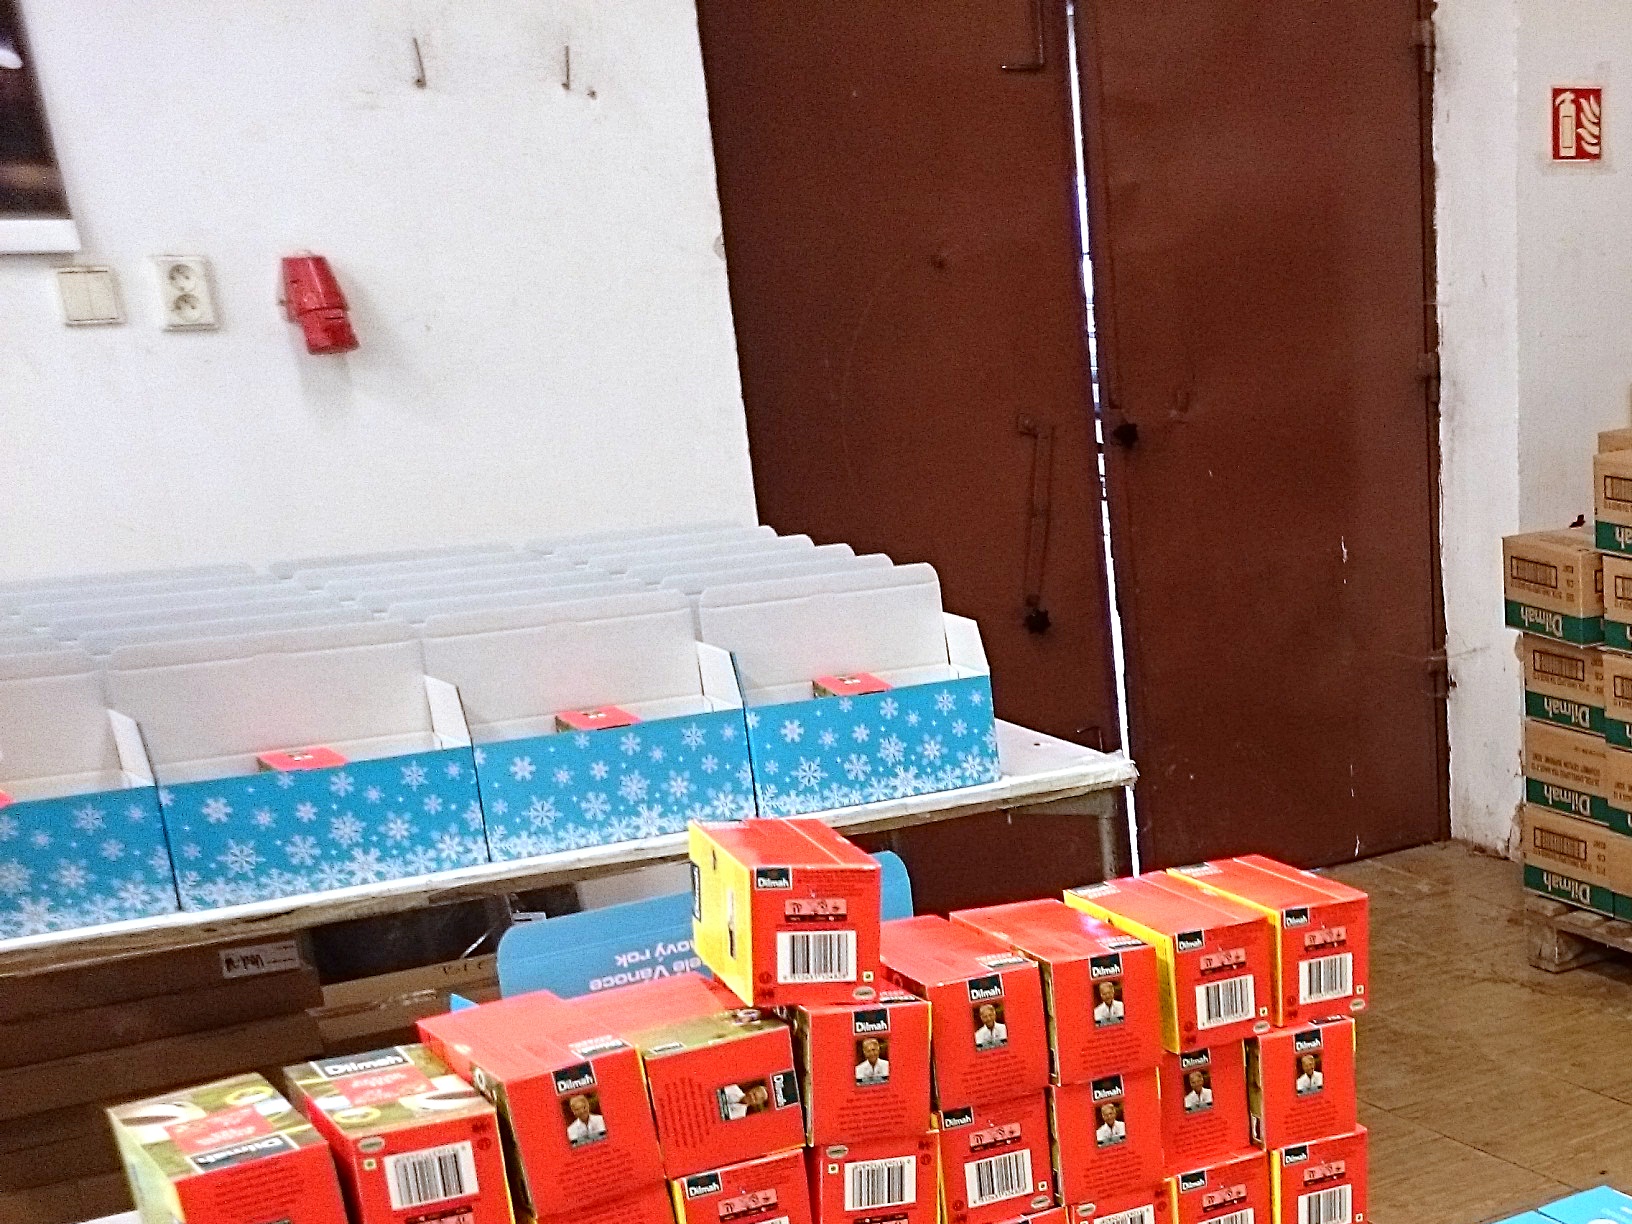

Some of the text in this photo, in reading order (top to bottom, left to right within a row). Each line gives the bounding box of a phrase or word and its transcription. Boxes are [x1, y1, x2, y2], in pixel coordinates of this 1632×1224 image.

[1521, 605, 1562, 637] Dilmah
[1545, 697, 1589, 728] Dilmah
[1544, 785, 1590, 816] Dilmah
[757, 876, 789, 888] Dilmah
[1543, 871, 1590, 904] Dilmah
[1177, 938, 1202, 951] Dilmah
[614, 941, 694, 968] ový rok
[1092, 963, 1121, 978] Dilmah
[970, 985, 1001, 1000] Dilmah
[855, 1019, 888, 1033] Dilmah
[1296, 1038, 1321, 1051] Dilmah
[1182, 1055, 1209, 1068] Dilmah
[557, 1074, 594, 1092] Dilmah
[1093, 1086, 1122, 1101] Dilmah
[944, 1113, 972, 1128] Dilmah
[1284, 1153, 1307, 1164] Dilmah
[688, 1182, 719, 1198] Dilmah
[1182, 1178, 1205, 1190] Dilmah
